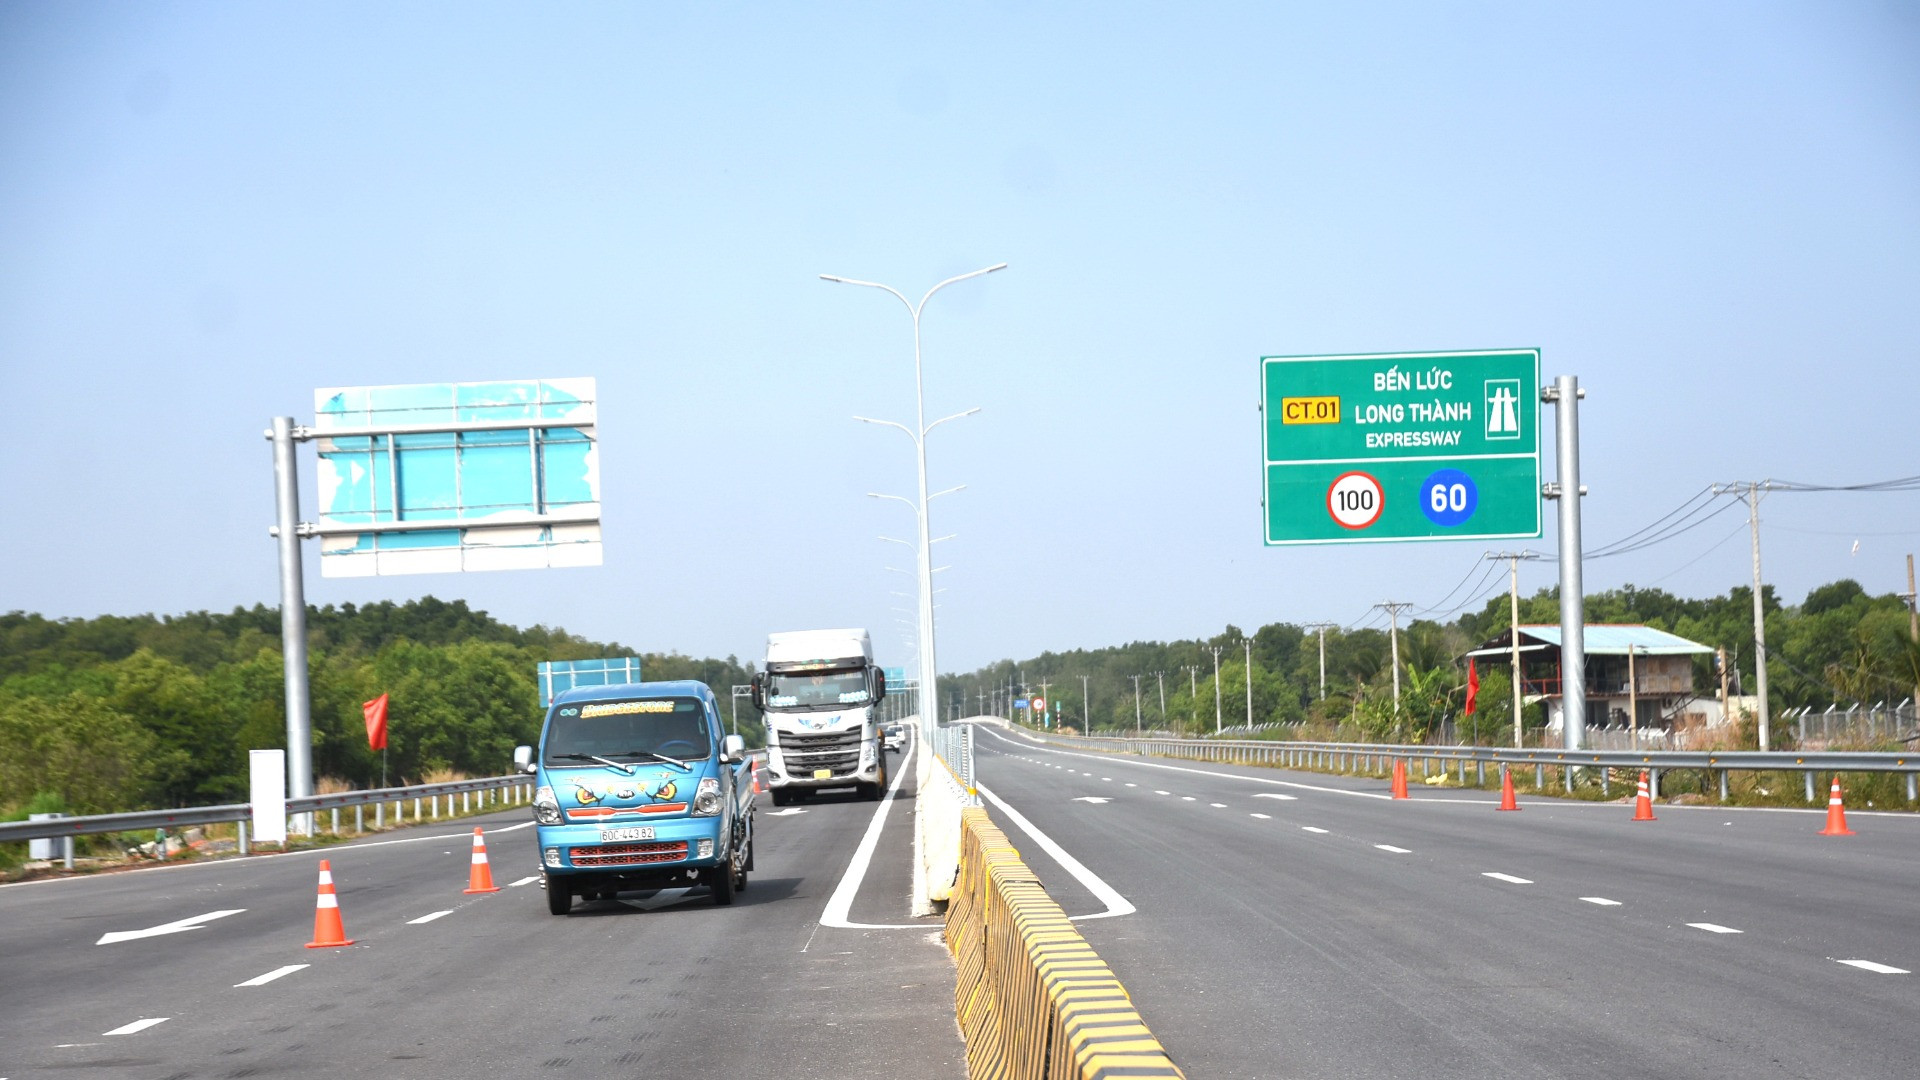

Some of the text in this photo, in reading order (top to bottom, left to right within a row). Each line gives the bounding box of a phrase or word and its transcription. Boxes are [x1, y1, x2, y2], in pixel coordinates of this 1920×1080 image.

[1374, 365, 1452, 391] BẾN LỨC
[1286, 401, 1337, 420] CT.01
[1355, 398, 1472, 424] LONG THÀNH
[1366, 430, 1462, 448] EXPRESSWAY
[1337, 489, 1374, 511] 100
[1430, 483, 1467, 512] 60
